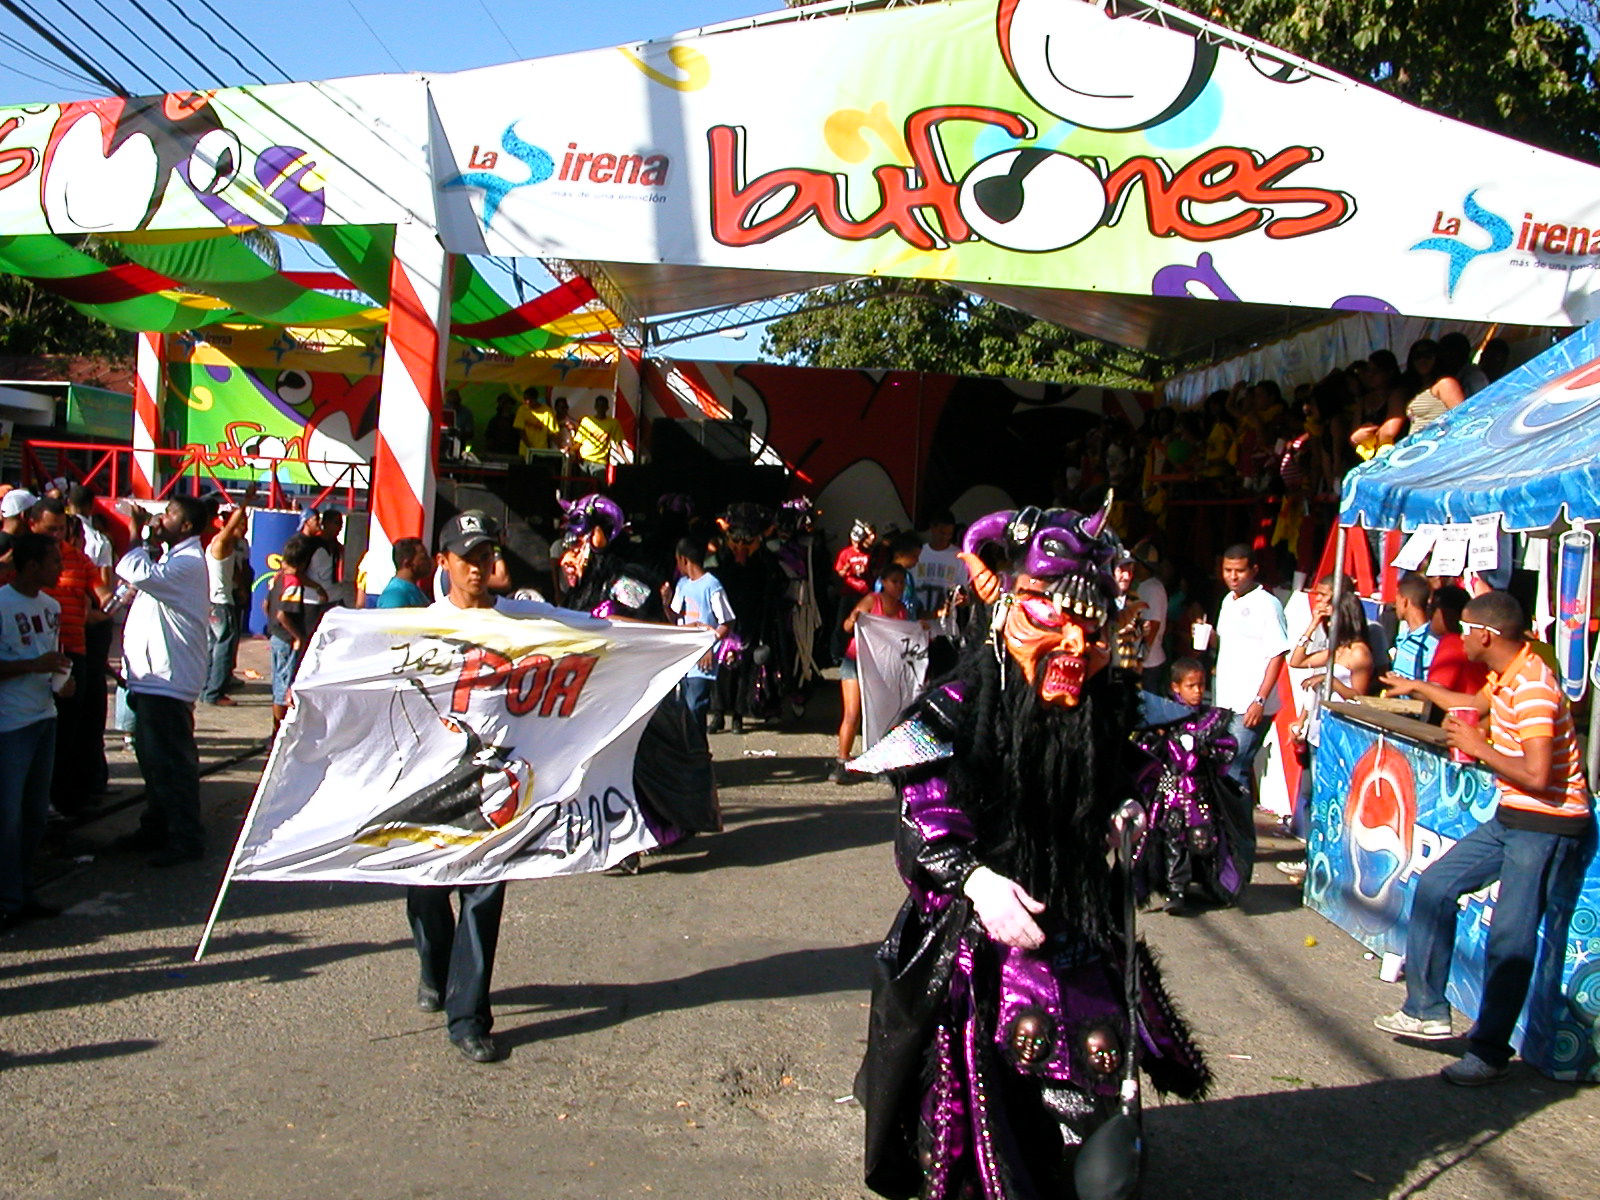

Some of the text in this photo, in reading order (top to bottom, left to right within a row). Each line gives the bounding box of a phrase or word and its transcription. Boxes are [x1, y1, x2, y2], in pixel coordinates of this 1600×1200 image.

[468, 145, 498, 169] La
[707, 104, 1357, 252] bufones
[1432, 210, 1461, 235] La
